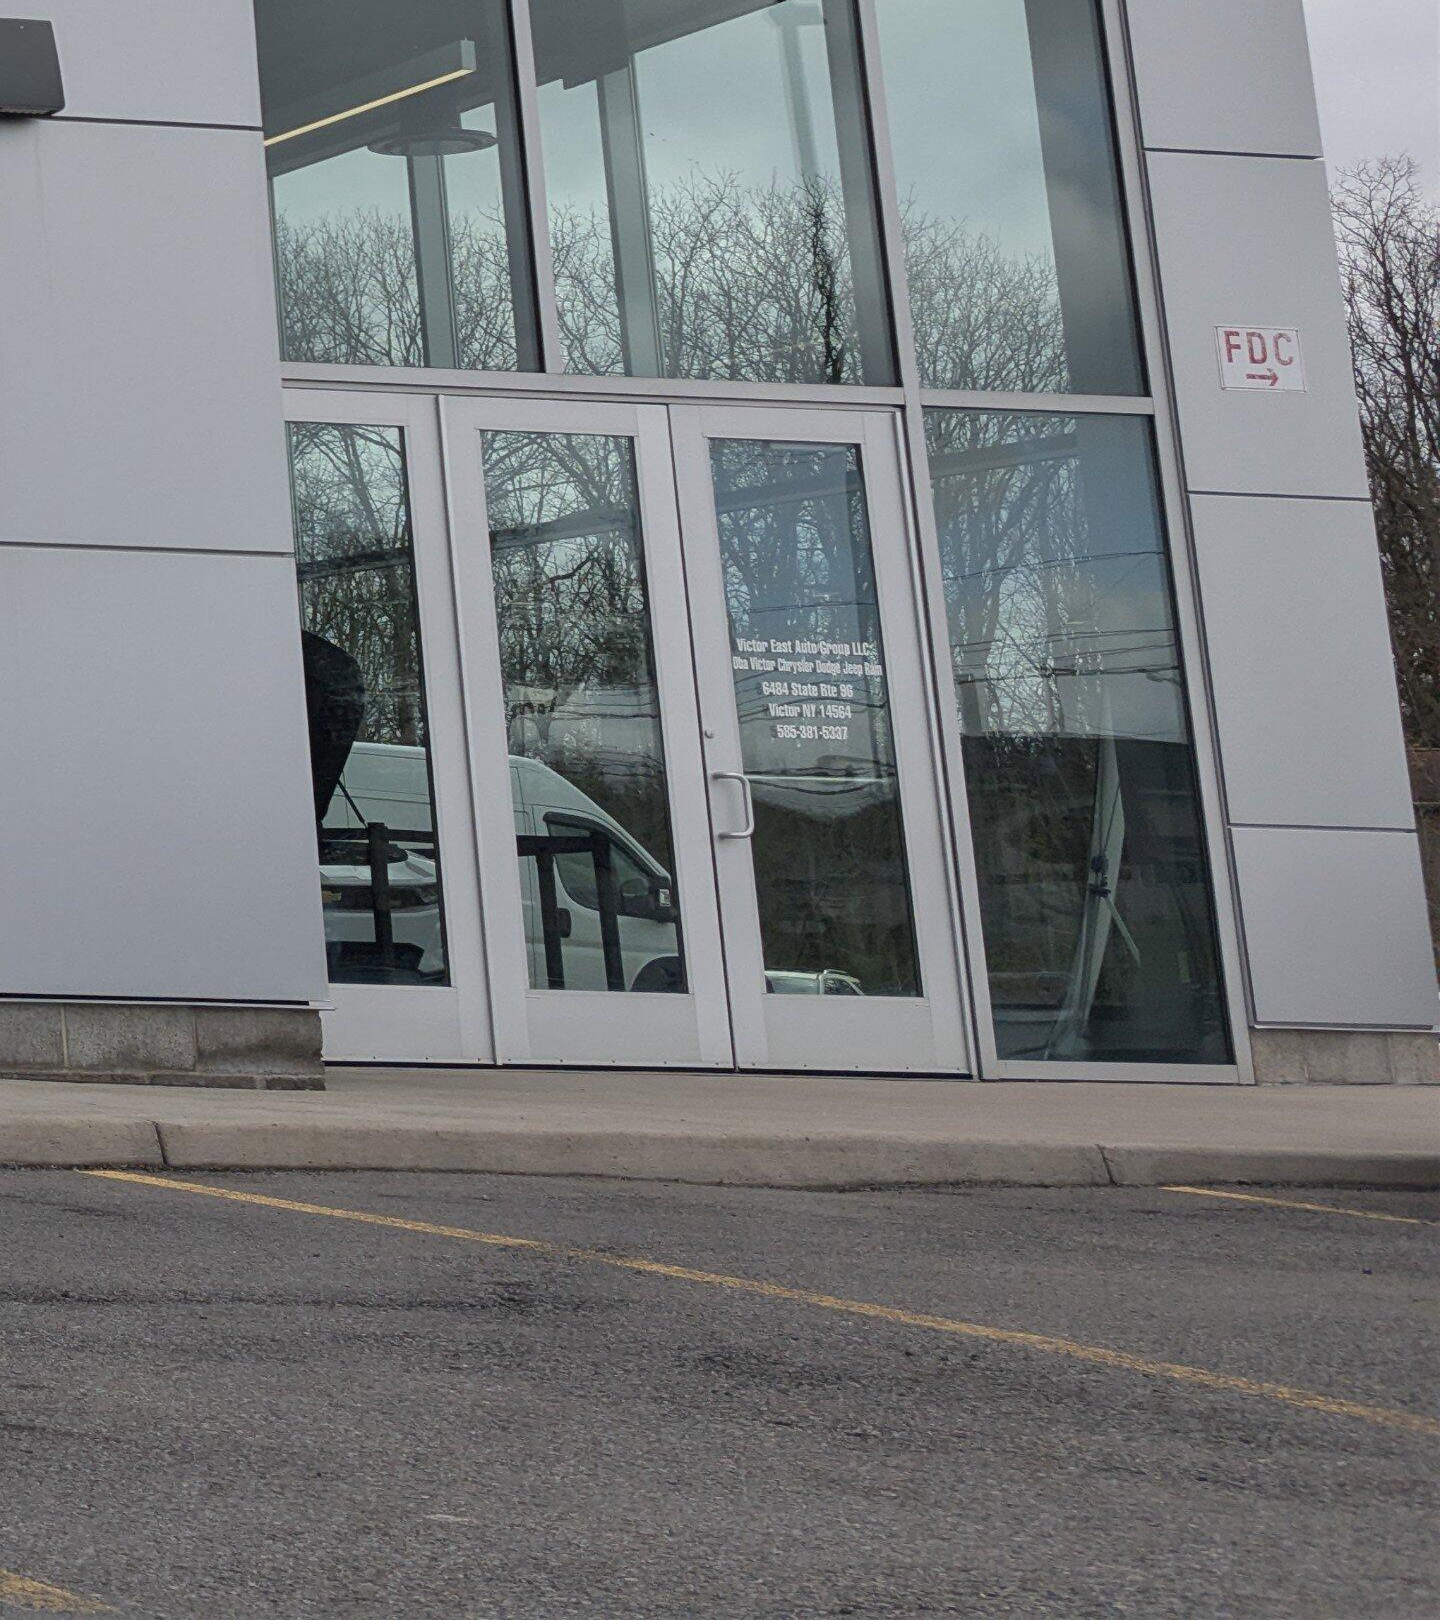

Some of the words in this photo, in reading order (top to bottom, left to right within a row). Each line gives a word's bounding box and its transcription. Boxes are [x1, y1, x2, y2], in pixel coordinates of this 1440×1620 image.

[1224, 330, 1294, 367] FDC
[736, 638, 768, 653] Victor
[770, 639, 793, 653] East
[795, 639, 817, 655] Auto
[820, 640, 851, 656] Group
[749, 656, 776, 671] Victor
[777, 657, 814, 675] Chrysler
[815, 660, 841, 676] Dodge
[842, 661, 863, 677] Jeep
[762, 681, 789, 696] 6484
[791, 682, 818, 697] State
[820, 683, 838, 697] Rte
[839, 684, 854, 698] 96
[768, 702, 800, 717] Victor
[802, 703, 816, 717] NY
[820, 704, 852, 719] 14564
